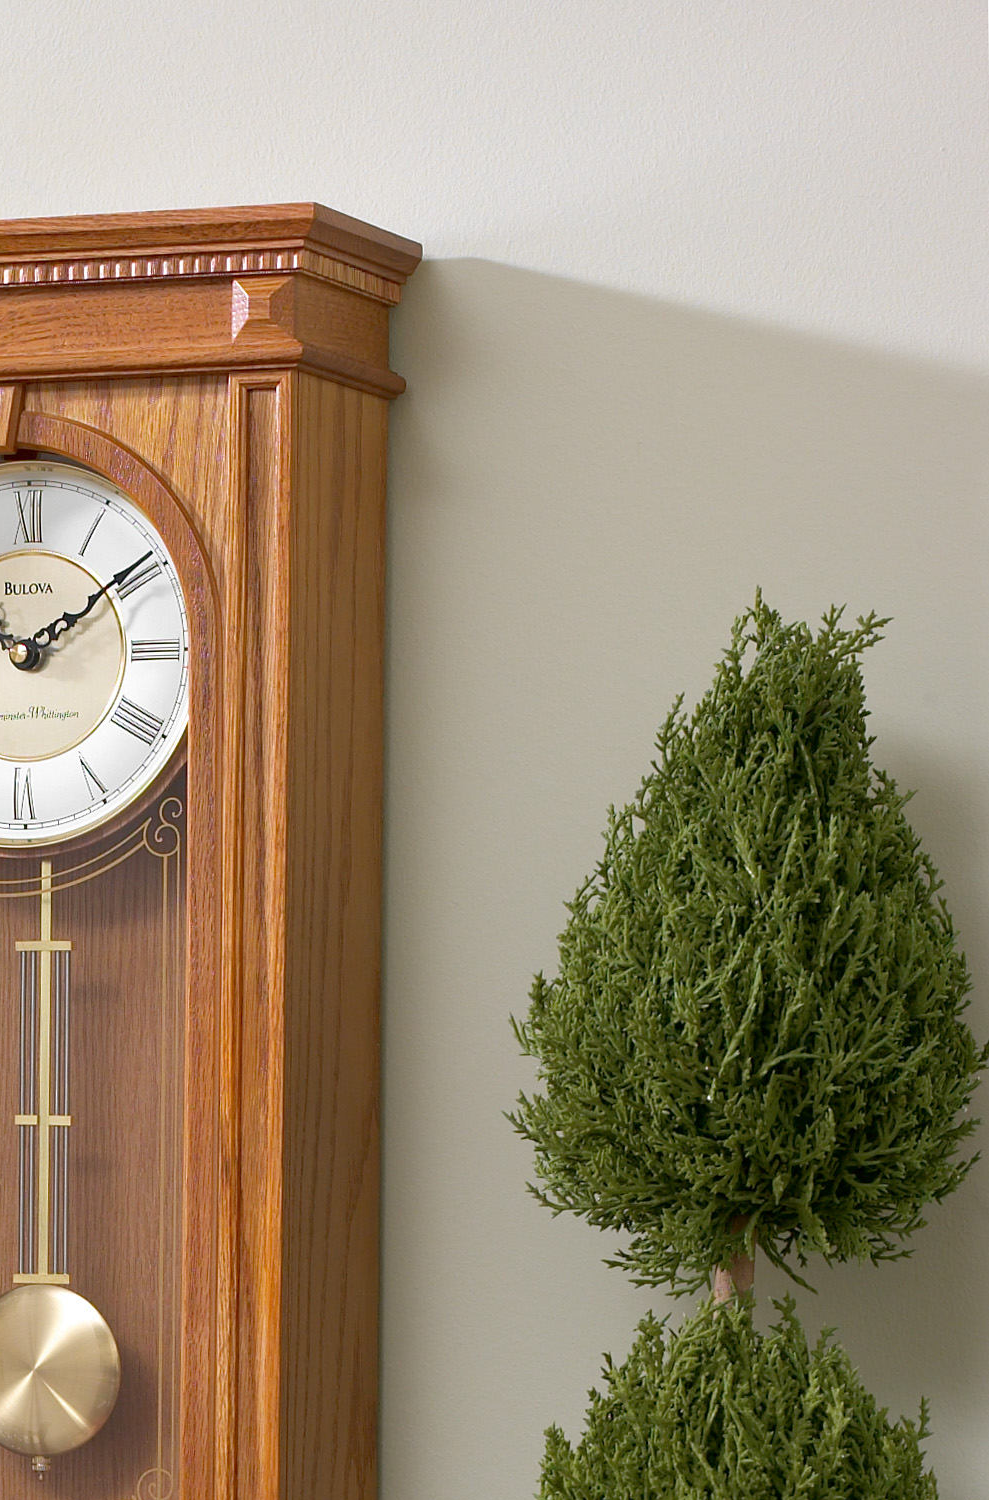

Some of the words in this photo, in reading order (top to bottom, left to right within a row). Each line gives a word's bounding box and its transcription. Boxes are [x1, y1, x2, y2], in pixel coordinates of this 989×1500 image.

[14, 490, 43, 545] XII
[78, 507, 106, 557] I
[131, 638, 180, 662] III
[13, 767, 37, 820] VI
[78, 751, 109, 801] V
